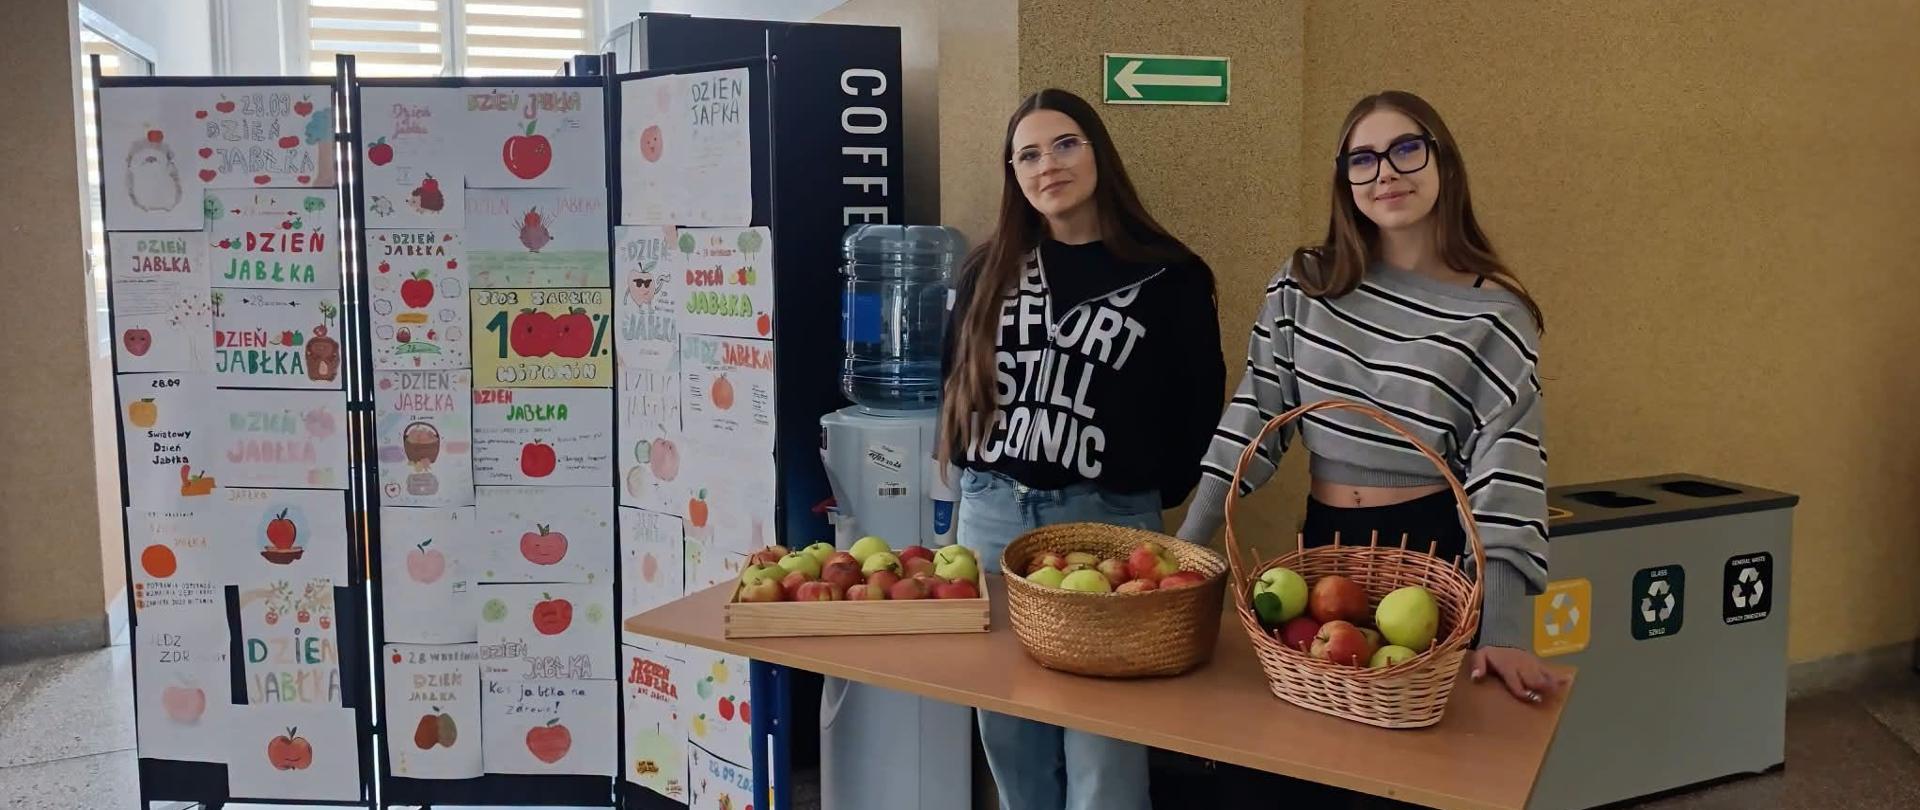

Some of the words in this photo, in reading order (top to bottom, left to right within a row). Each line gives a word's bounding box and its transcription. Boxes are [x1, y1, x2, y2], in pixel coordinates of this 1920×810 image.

[241, 93, 291, 117] 28.09
[841, 68, 888, 226] COFFE
[385, 245, 445, 256] JABŁKA
[132, 255, 191, 273] JABŁKA
[224, 258, 315, 283] JABŁKA
[996, 294, 1147, 371] FFORT
[216, 350, 304, 375] JABŁKA
[152, 378, 181, 388] 28.09
[996, 348, 1096, 419] STILL
[394, 392, 454, 411] JABŁKA
[506, 404, 568, 421] JABŁKA
